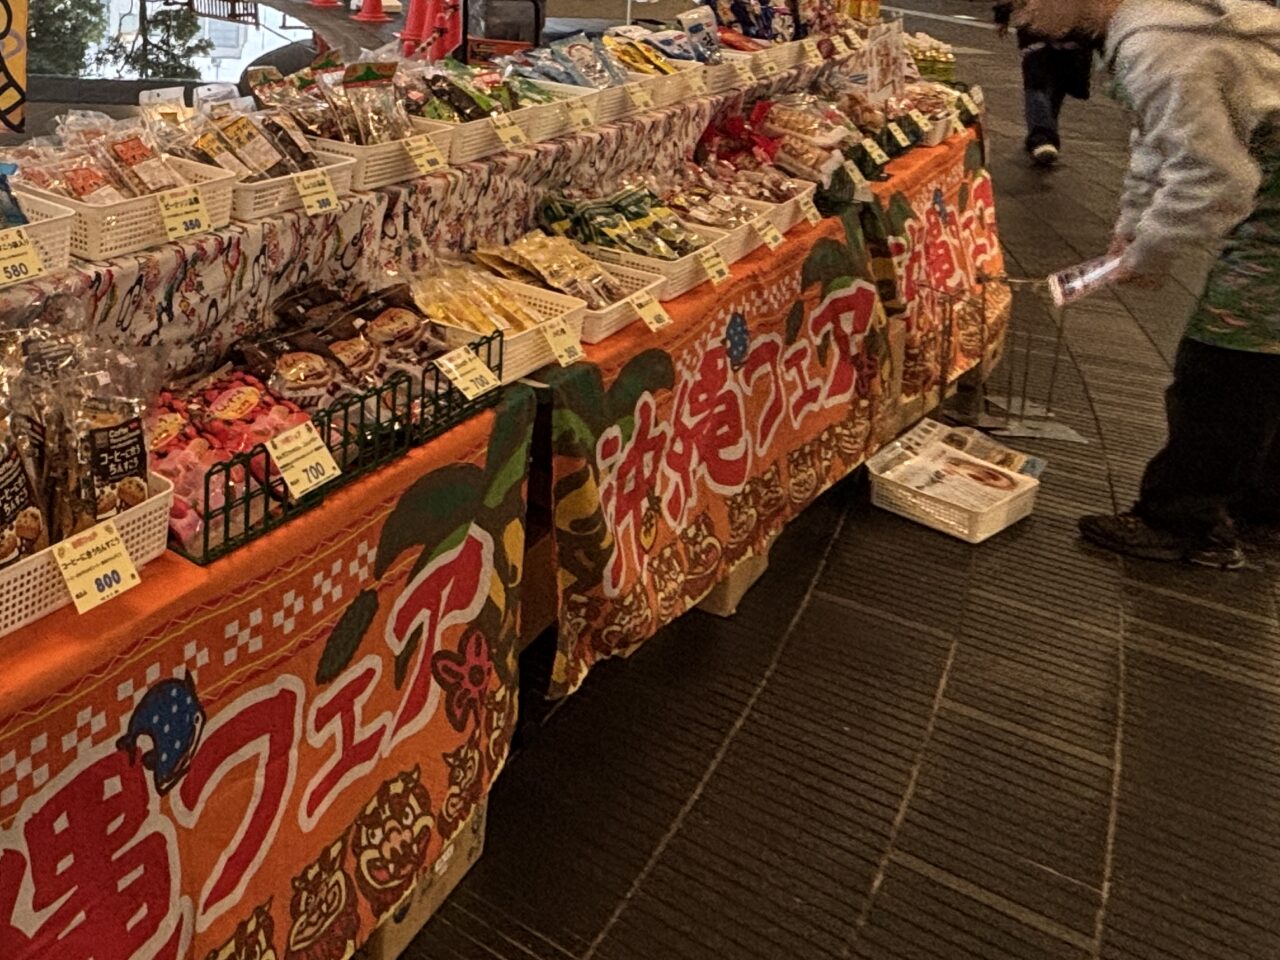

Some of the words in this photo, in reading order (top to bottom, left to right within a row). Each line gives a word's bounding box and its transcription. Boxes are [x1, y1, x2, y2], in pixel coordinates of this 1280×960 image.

[3, 262, 29, 280] 580
[596, 279, 878, 596] 沖縄フェア
[302, 461, 326, 483] 700
[95, 569, 121, 593] 800
